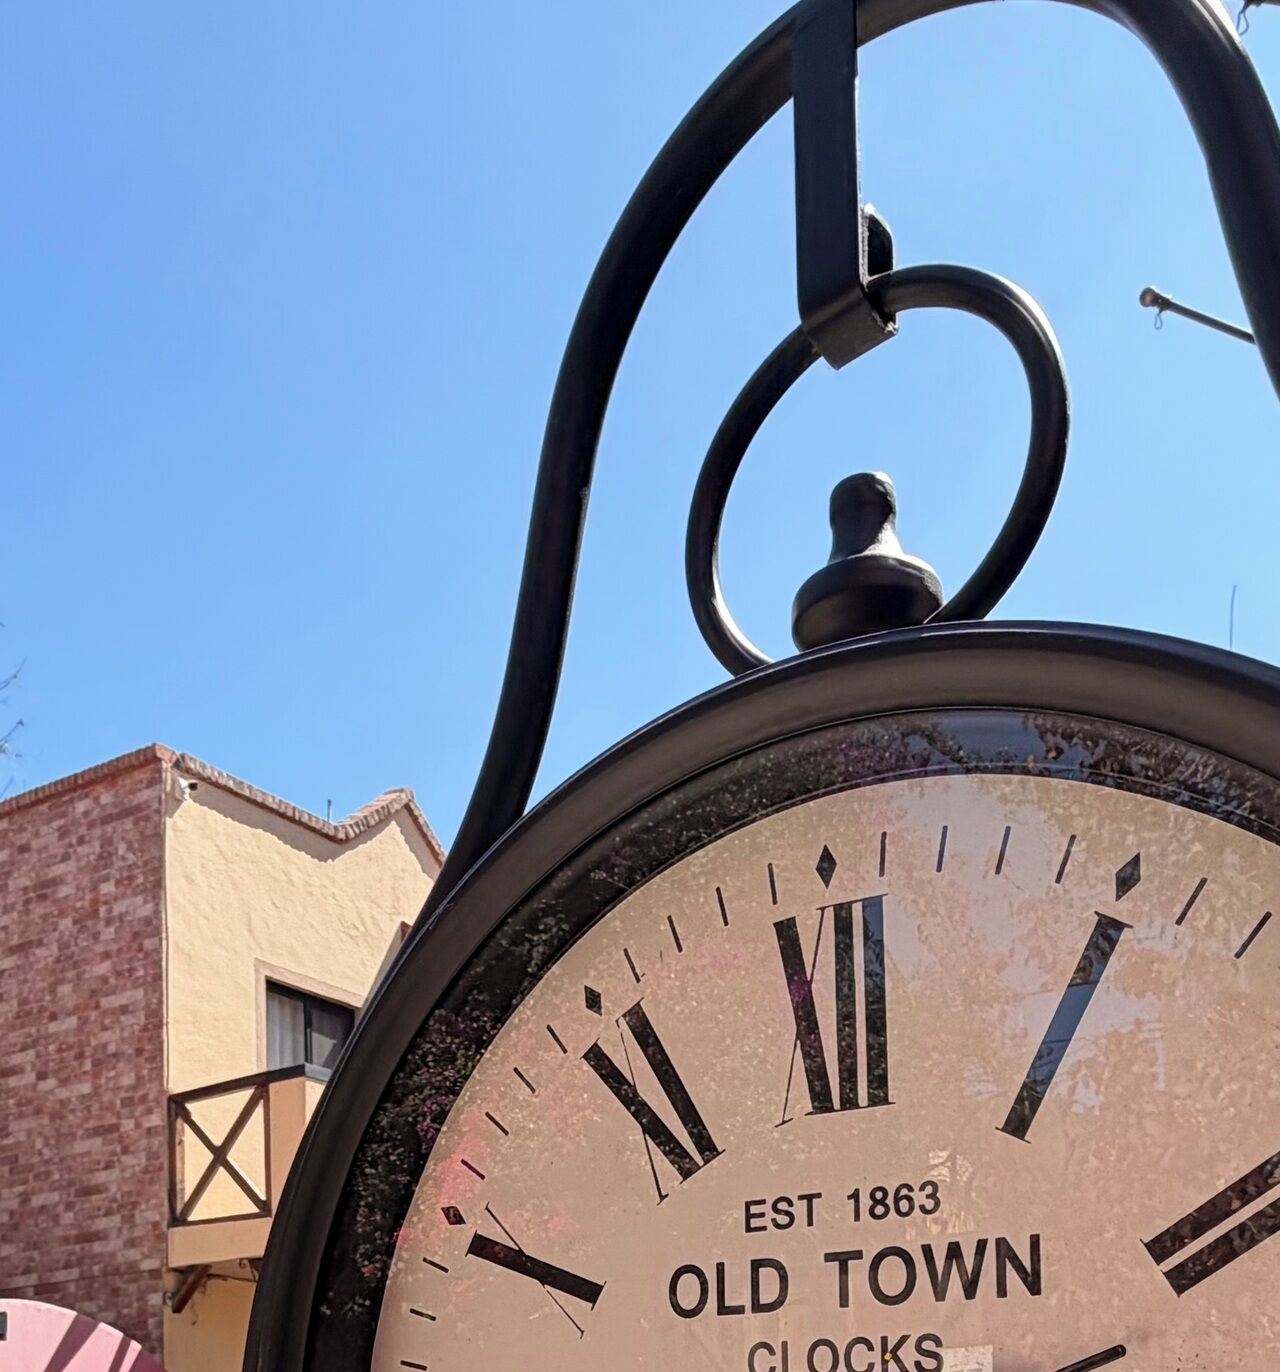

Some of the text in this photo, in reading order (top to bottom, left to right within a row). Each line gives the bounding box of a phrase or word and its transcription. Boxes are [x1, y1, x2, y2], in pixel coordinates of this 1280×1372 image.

[773, 894, 894, 1127] XII
[744, 1180, 940, 1232] EST 1863
[668, 1234, 1042, 1319] OLD TOWN
